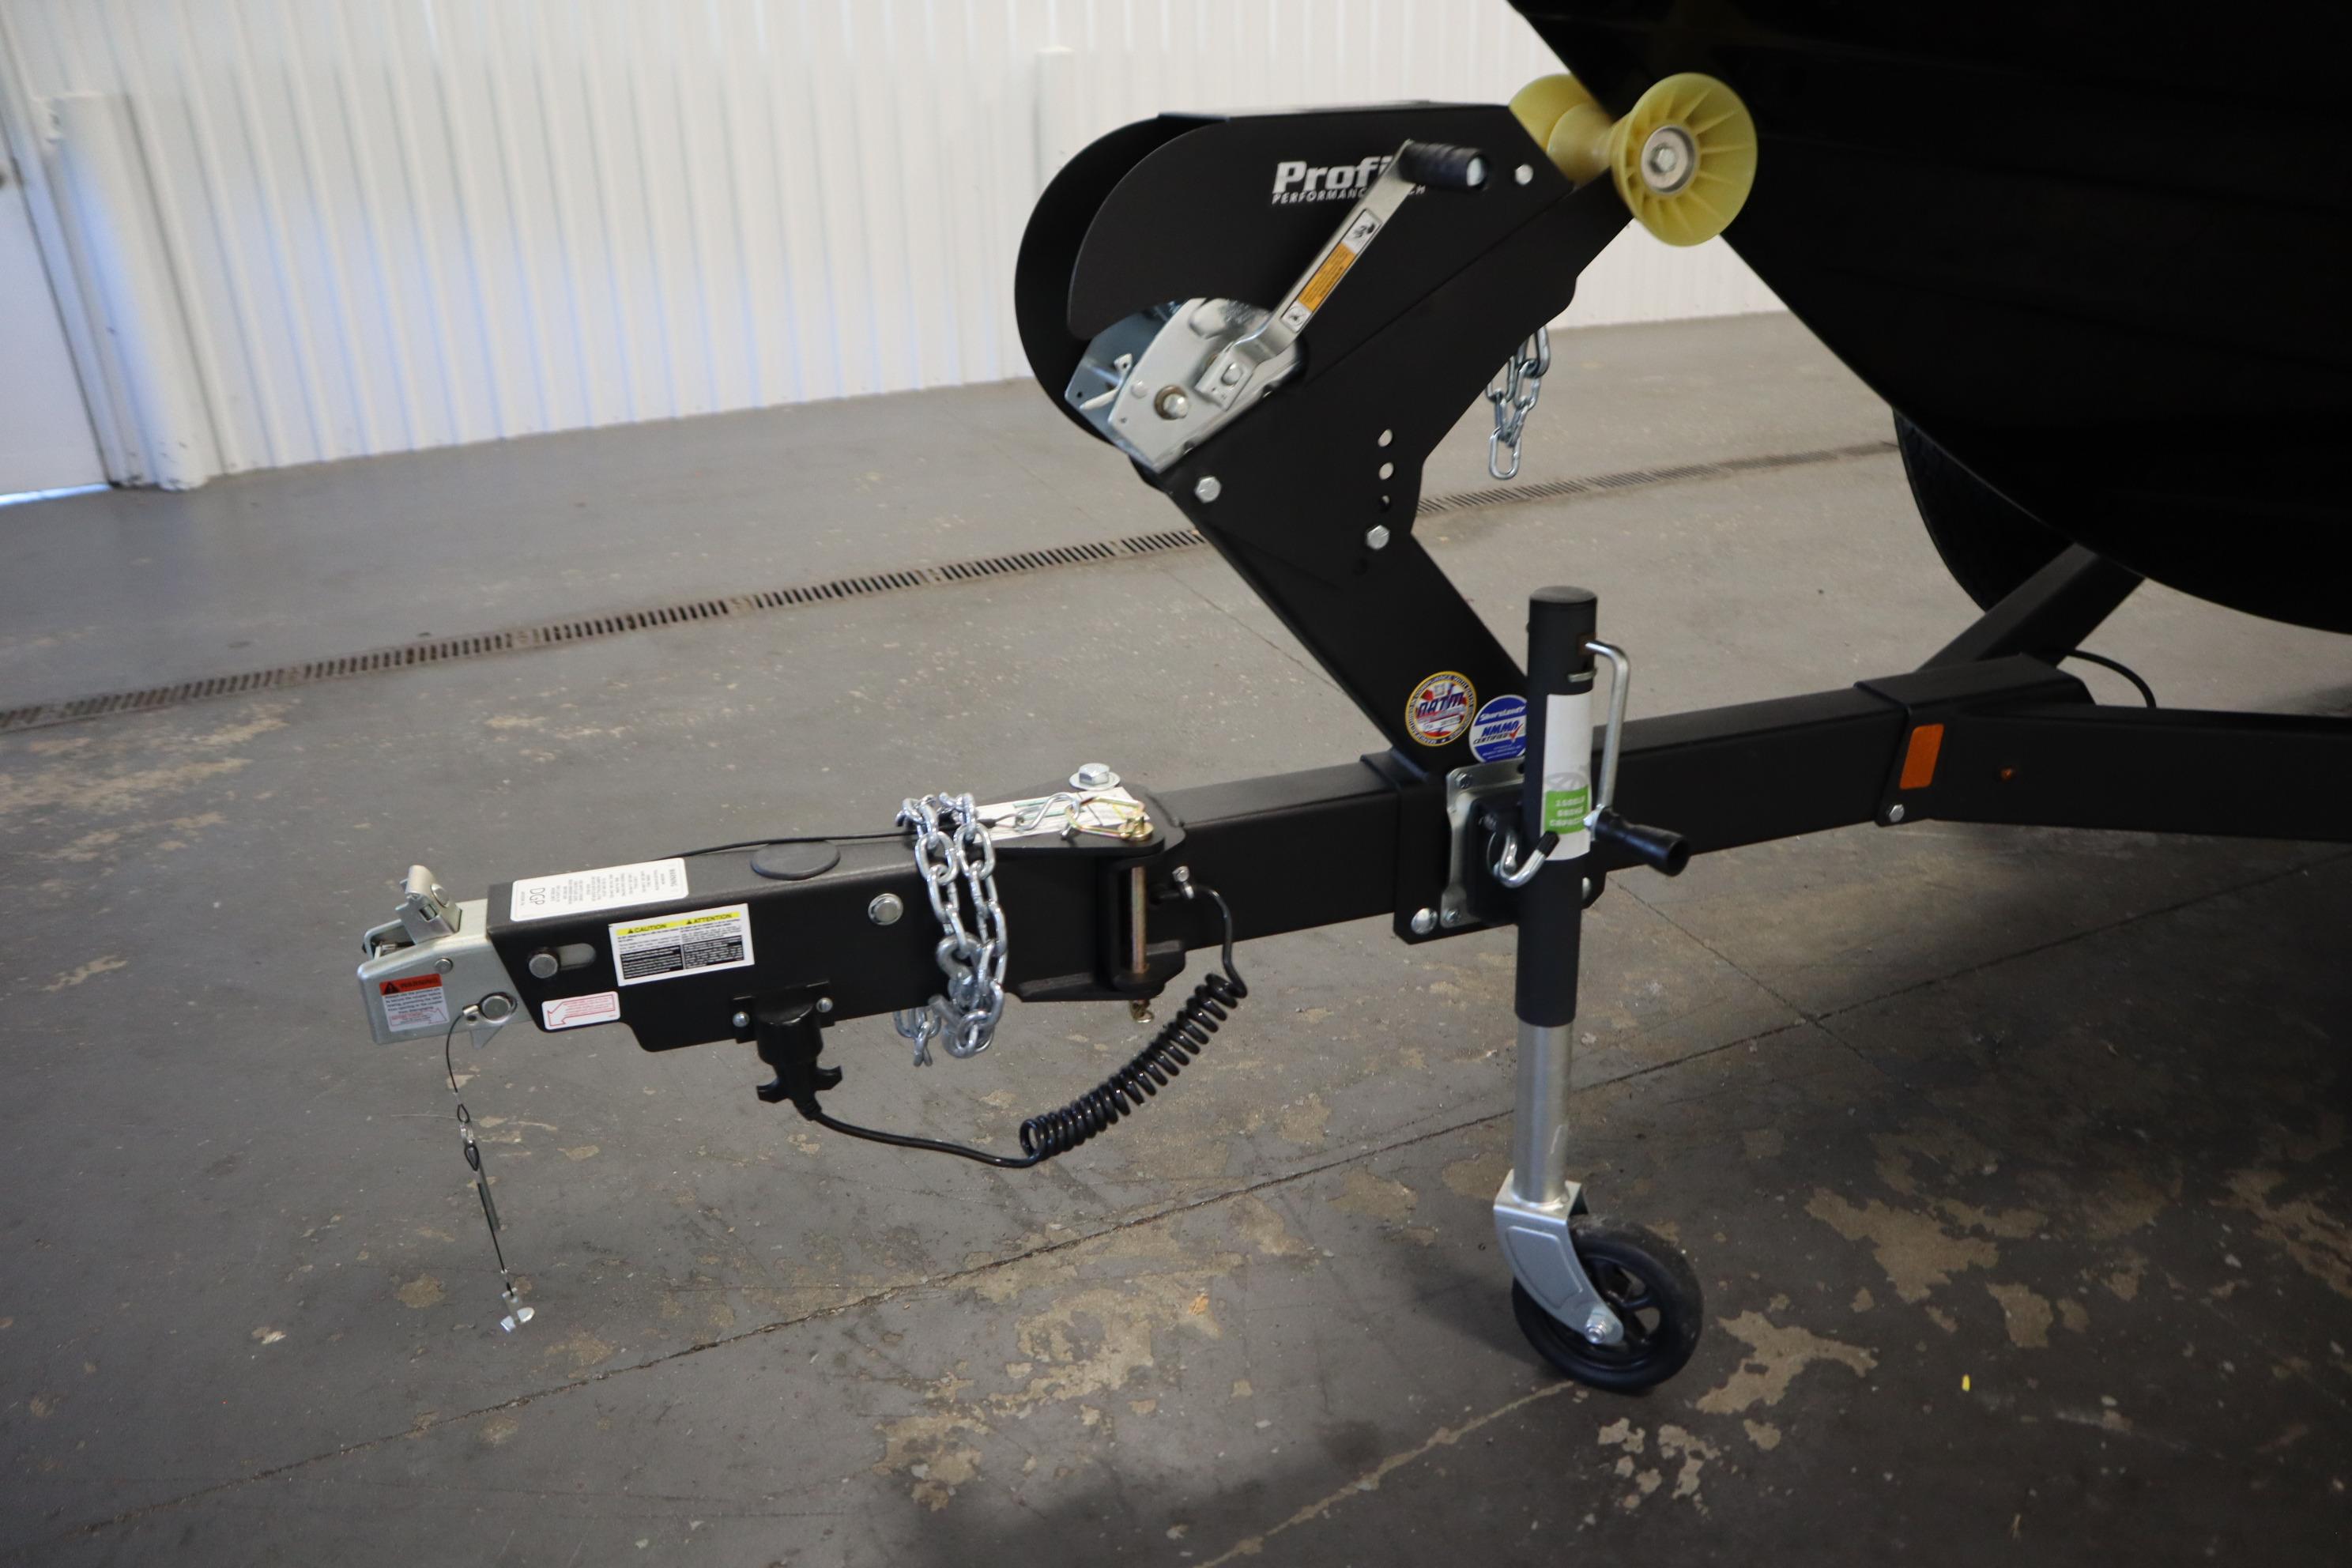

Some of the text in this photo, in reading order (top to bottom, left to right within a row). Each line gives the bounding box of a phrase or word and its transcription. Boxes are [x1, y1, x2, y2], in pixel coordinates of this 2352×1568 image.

[1272, 187, 1368, 205] PERFORMANC
[693, 913, 733, 924] ATTENTION
[634, 923, 667, 933] CAUTION
